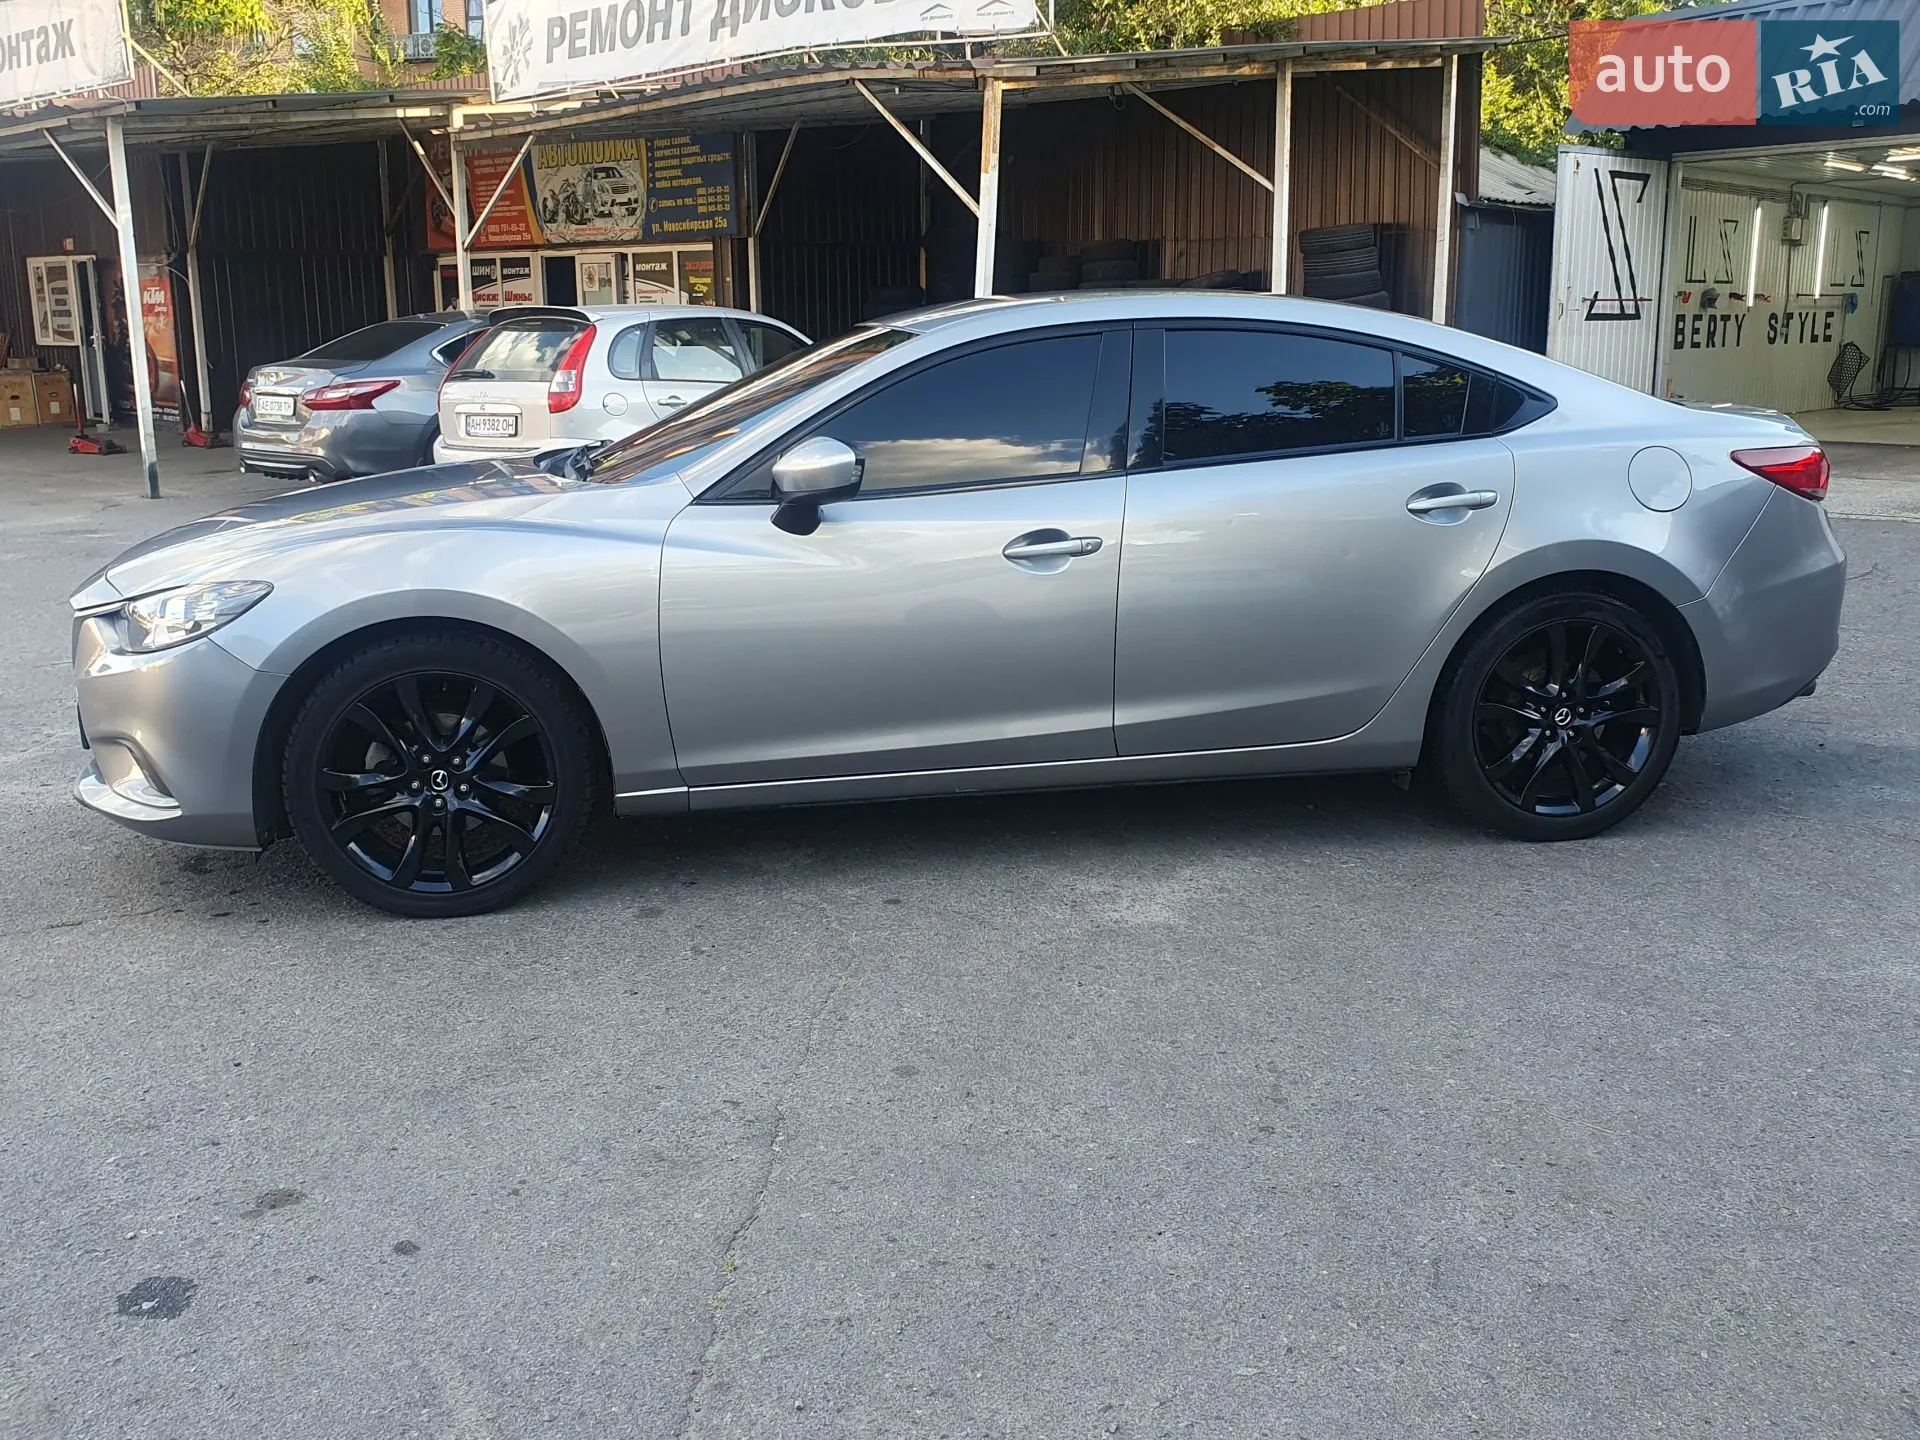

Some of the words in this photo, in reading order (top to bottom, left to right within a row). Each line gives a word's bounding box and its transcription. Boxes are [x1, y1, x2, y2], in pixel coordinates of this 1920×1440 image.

[546, 0, 692, 64] РЕМОНТ
[663, 218, 714, 232] Новосибирская
[635, 262, 668, 272] монтаж
[143, 286, 165, 304] KTM
[1673, 313, 1746, 350] BERTY
[1767, 311, 1835, 345] STYLE
[470, 418, 481, 431] AH
[482, 418, 500, 431] 9382
[501, 418, 515, 431] OH
